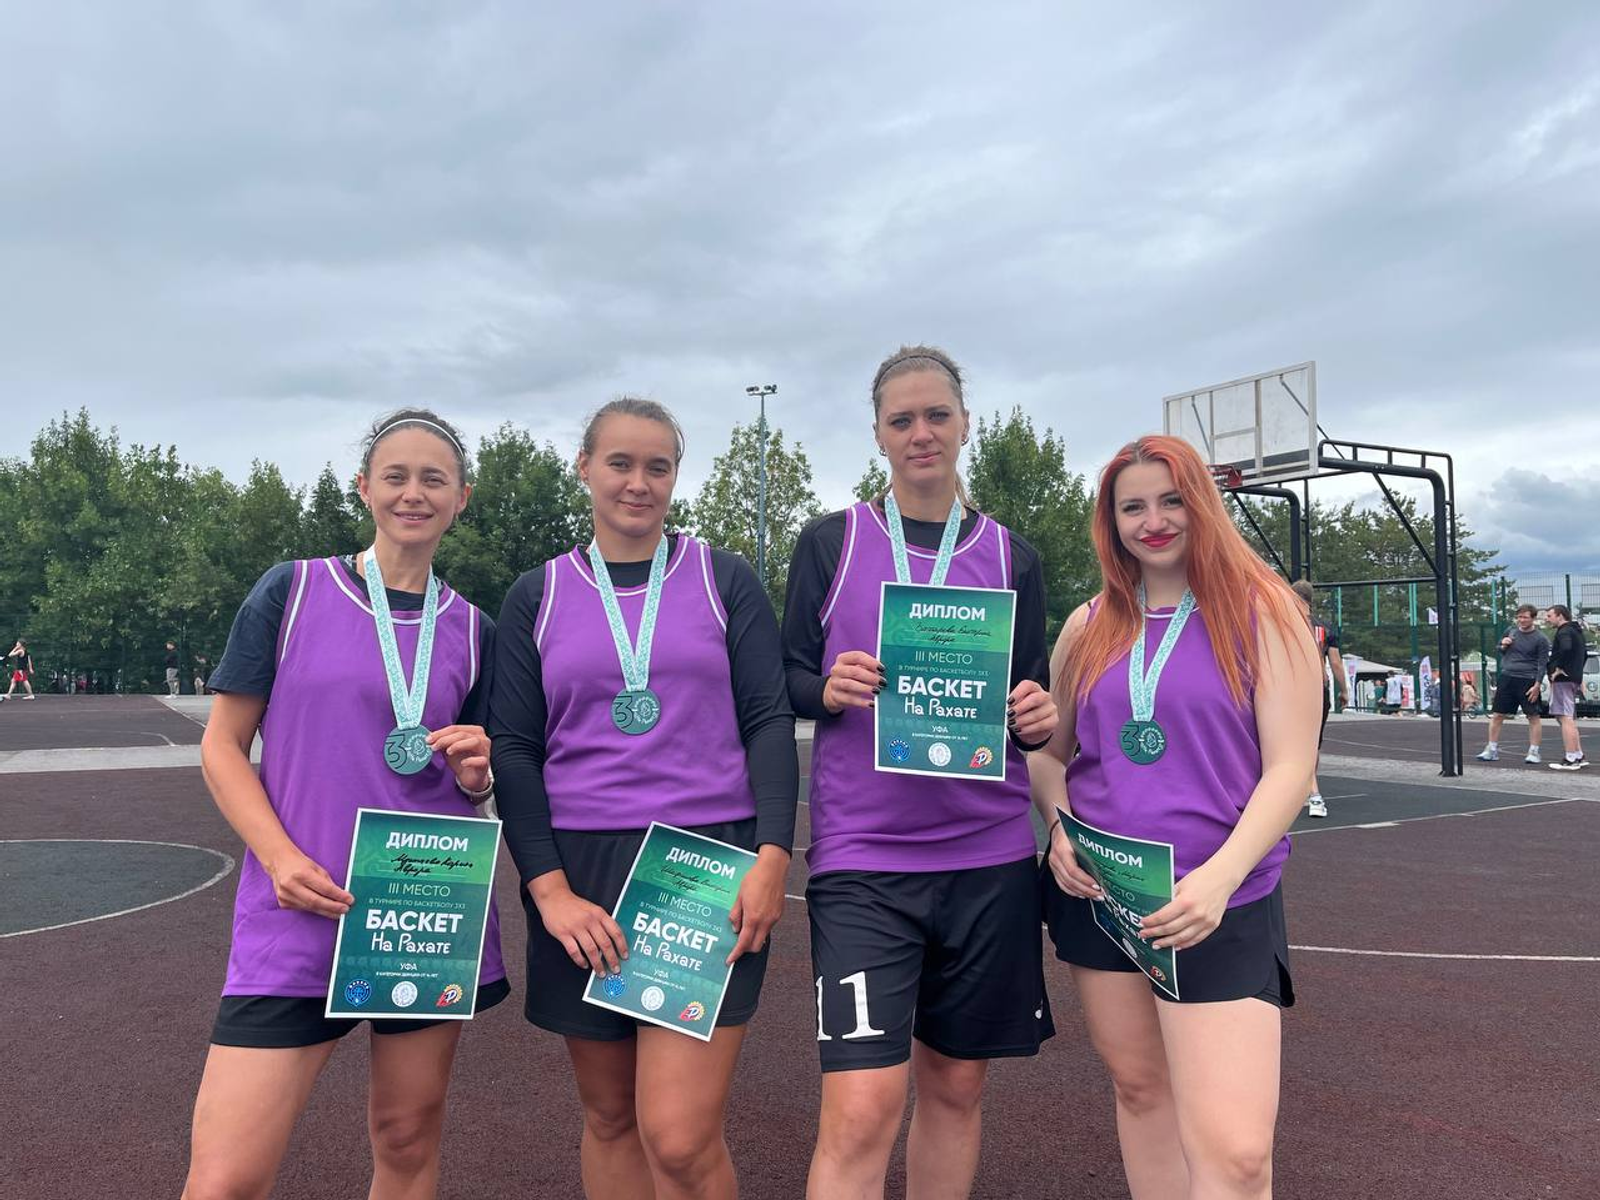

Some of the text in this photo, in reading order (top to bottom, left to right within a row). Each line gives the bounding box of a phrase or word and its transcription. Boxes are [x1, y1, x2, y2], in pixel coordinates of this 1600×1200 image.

[909, 603, 986, 621] ДИПЛОМ
[915, 650, 973, 665] III МЕСТО
[898, 675, 987, 699] БАСКЕТ
[904, 696, 924, 715] На
[931, 725, 949, 733] УФА
[386, 832, 469, 852] ДИПЛОМ
[1078, 833, 1143, 868] ДИПЛОМ
[665, 846, 736, 879] ДИПЛОМ
[388, 883, 451, 897] III МЕСТО
[670, 896, 712, 917] МЕСТО
[366, 909, 464, 933] БАСКЕТ
[371, 931, 393, 952] На
[632, 912, 719, 953] БАСКЕТ
[633, 934, 652, 956] На
[400, 963, 418, 971] УФА
[816, 971, 885, 1040] 11
